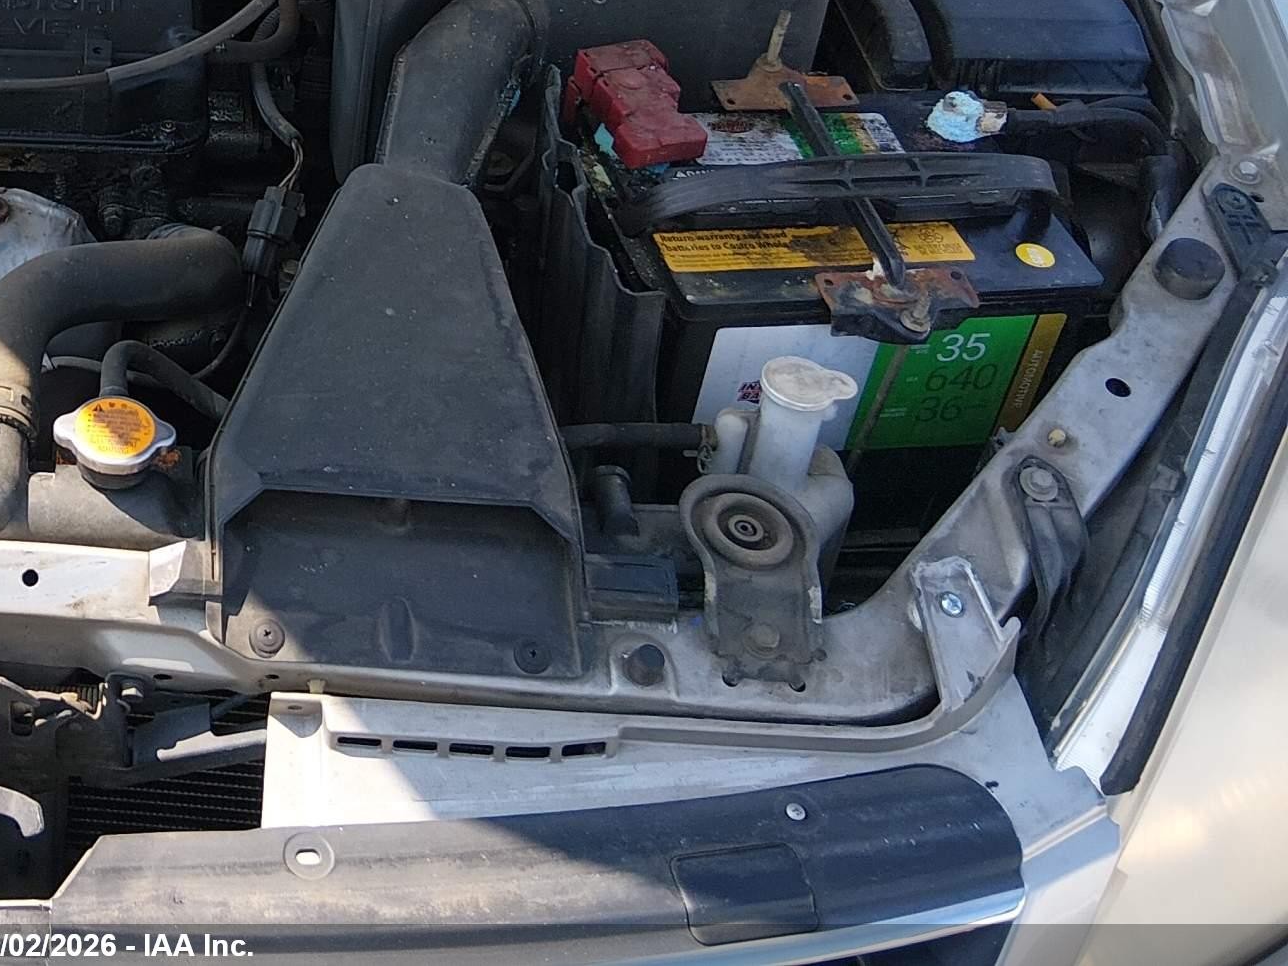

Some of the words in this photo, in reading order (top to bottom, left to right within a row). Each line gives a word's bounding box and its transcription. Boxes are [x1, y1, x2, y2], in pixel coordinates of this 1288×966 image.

[936, 332, 991, 362] 35
[925, 362, 998, 392] 640
[1014, 350, 1044, 409] AUTOMOTIVE
[914, 395, 964, 423] 36
